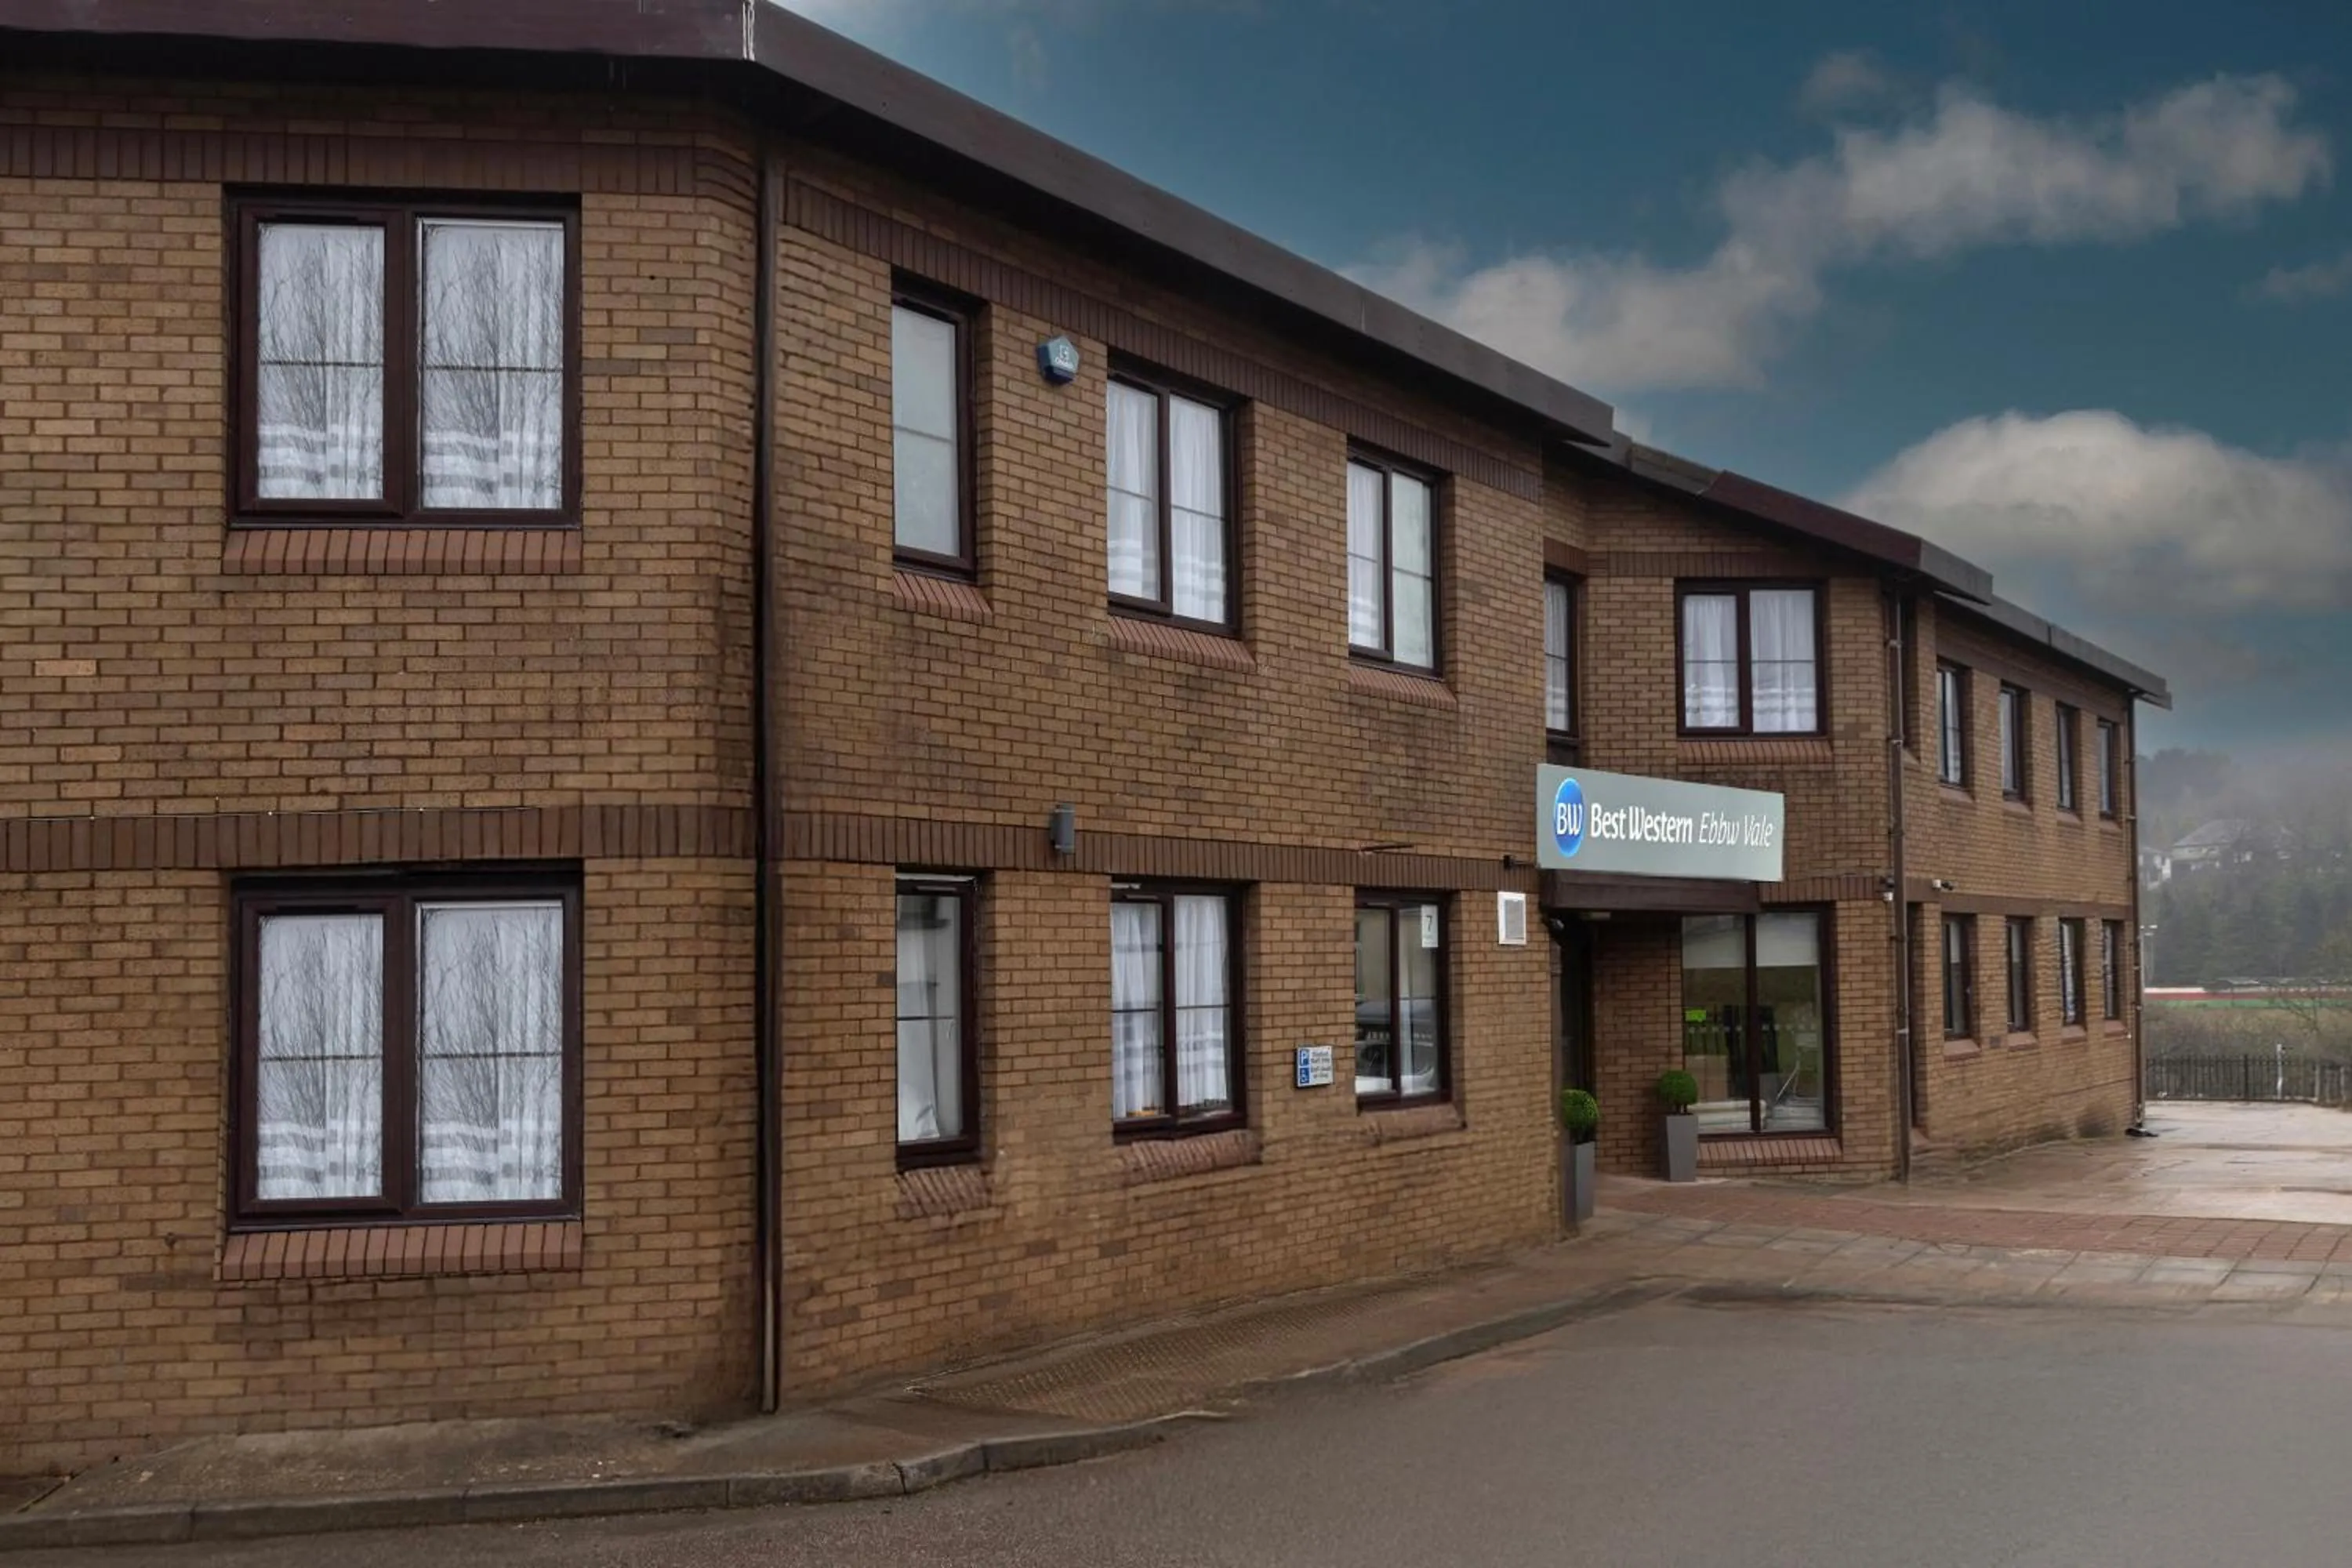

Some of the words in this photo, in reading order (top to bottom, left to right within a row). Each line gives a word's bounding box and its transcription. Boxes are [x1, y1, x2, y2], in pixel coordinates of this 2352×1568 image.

[1556, 802, 1583, 835] BW
[1591, 802, 1627, 840] Best
[1628, 805, 1693, 844] Western
[1699, 810, 1740, 845] Ebbw
[1744, 815, 1773, 848] Vale
[1301, 1050, 1308, 1065] P
